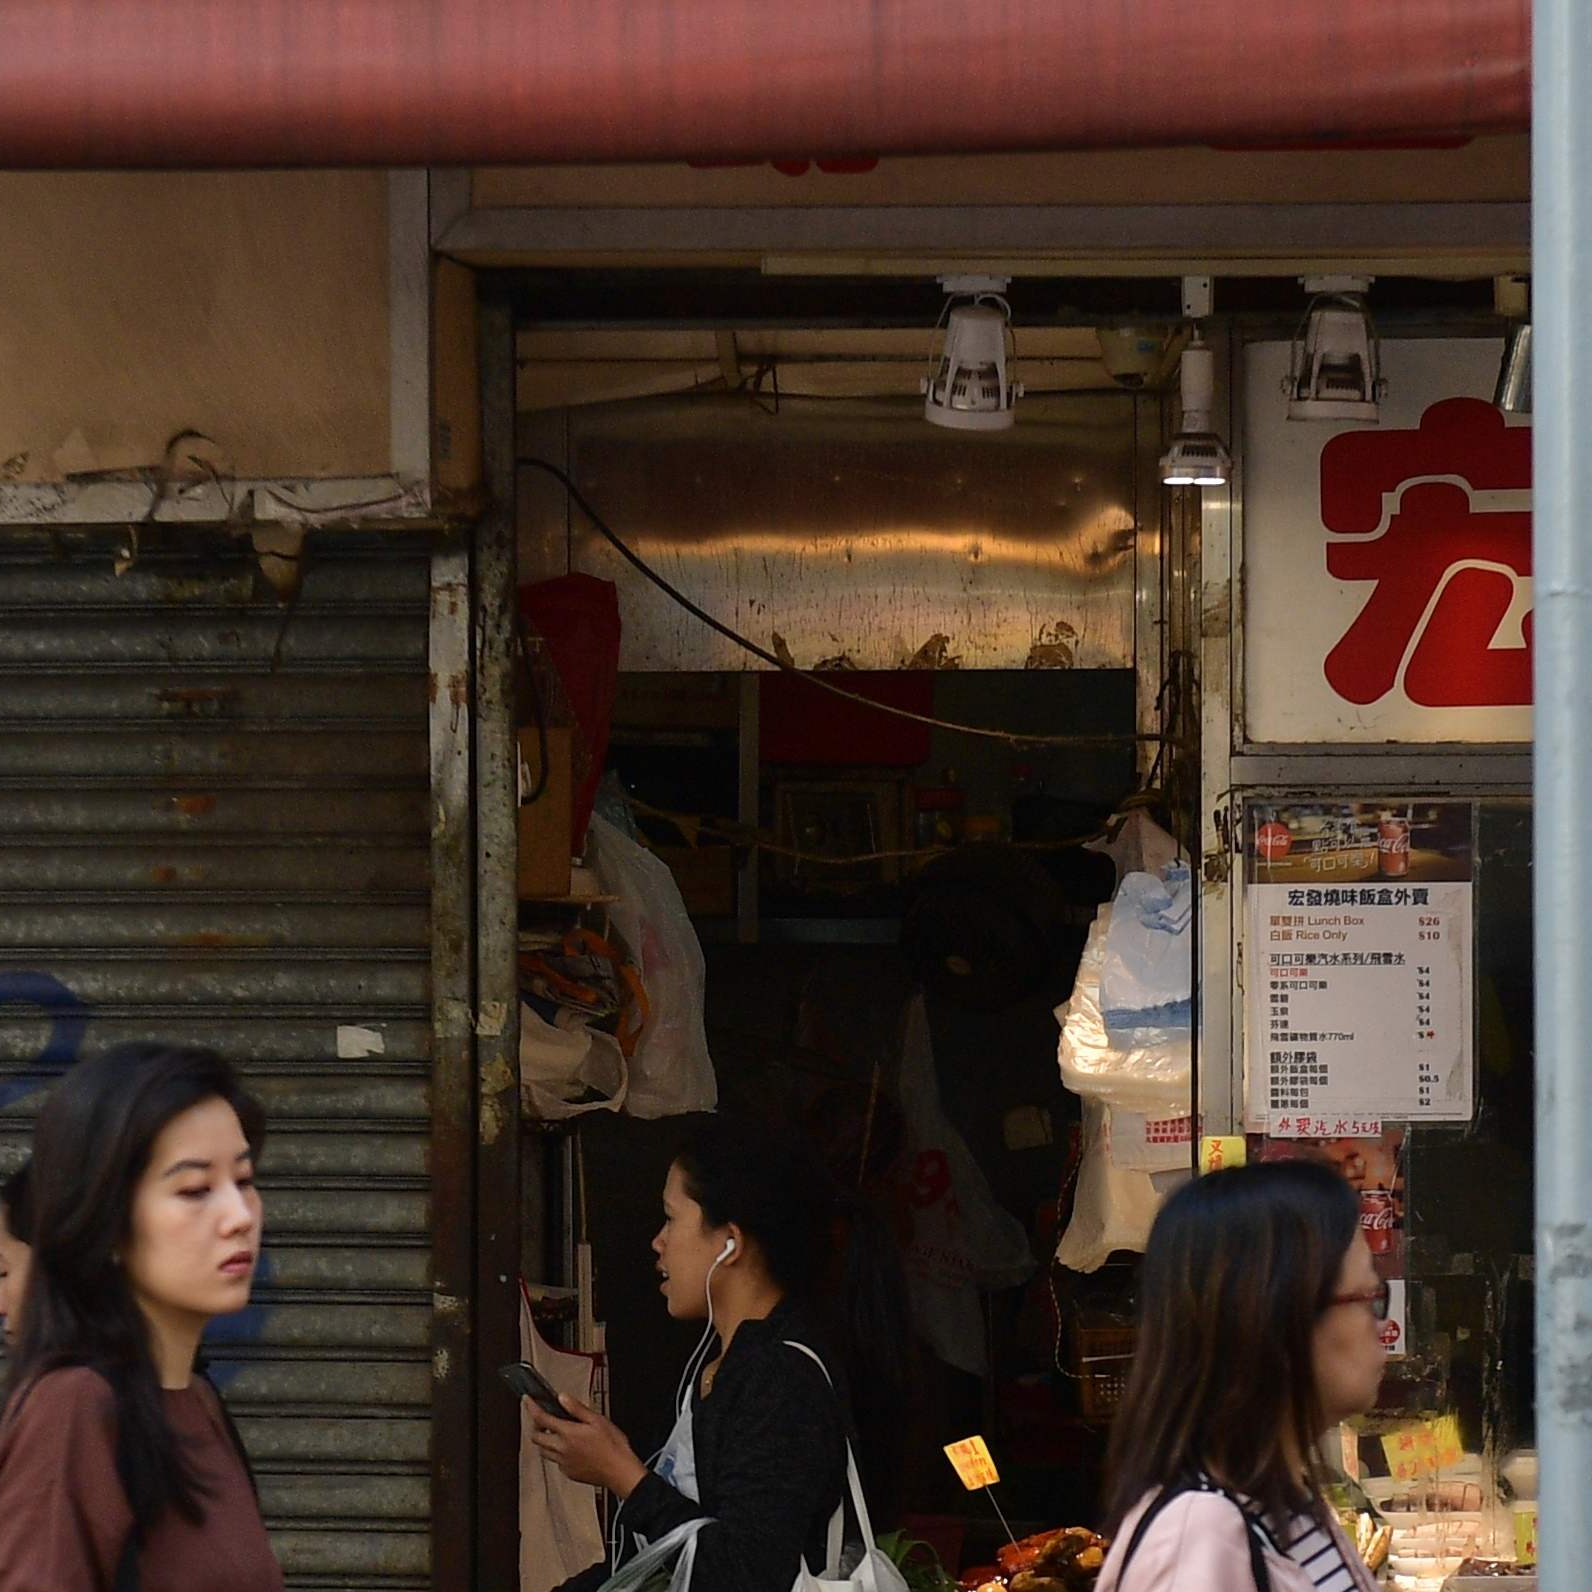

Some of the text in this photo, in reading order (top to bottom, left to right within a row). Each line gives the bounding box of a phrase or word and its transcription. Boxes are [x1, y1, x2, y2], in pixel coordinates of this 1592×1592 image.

[1288, 888, 1428, 906] 宏發燒味飯盒外賣
[1308, 916, 1341, 926] Lunch
[1344, 916, 1365, 926] Box
[1418, 916, 1440, 927] $26
[1270, 930, 1440, 942] 白飯 Rice Only $10
[1270, 953, 1405, 966] 可口可樂汽水系列/飛雪水
[1270, 968, 1308, 977] 可口可樂
[1418, 1064, 1430, 1072] $1
[1418, 1075, 1439, 1083] $0.5
[1418, 1087, 1430, 1095] $1
[1418, 1098, 1431, 1107] $2
